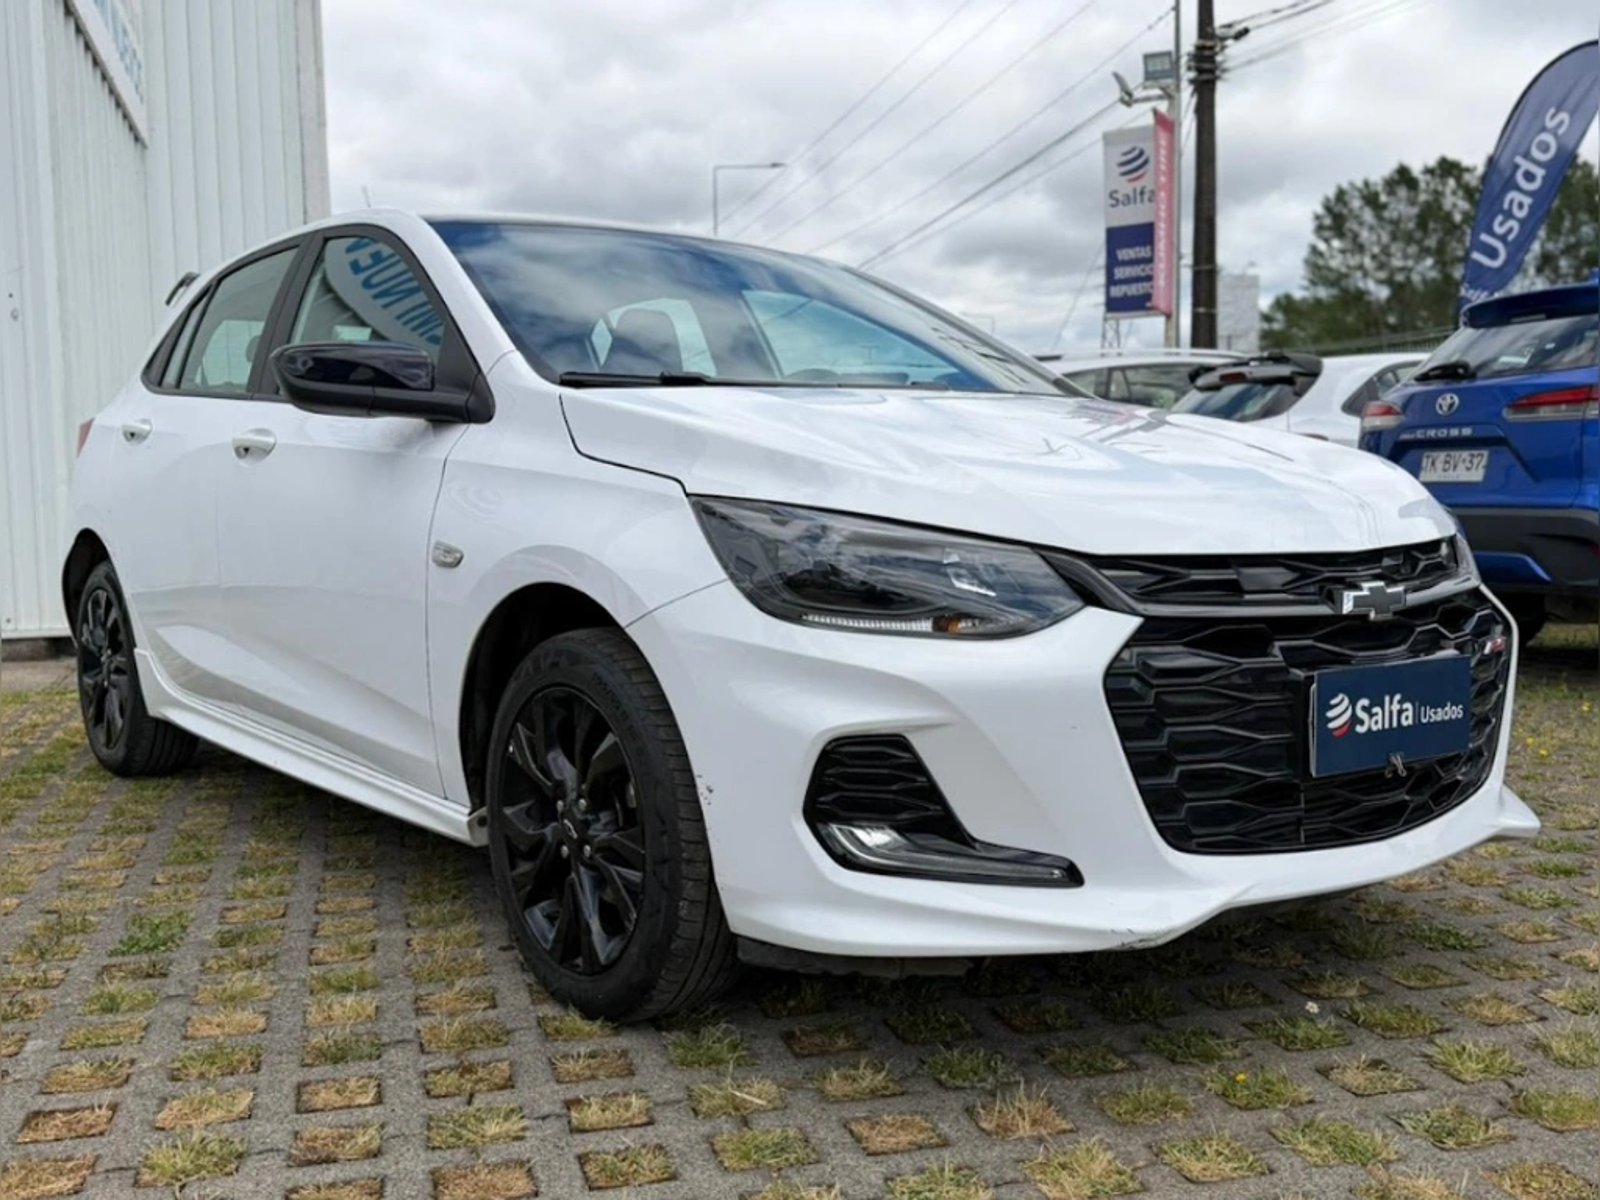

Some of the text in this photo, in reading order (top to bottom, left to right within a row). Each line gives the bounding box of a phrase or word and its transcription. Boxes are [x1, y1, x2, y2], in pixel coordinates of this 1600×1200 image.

[1109, 185, 1156, 208] Salfa
[1471, 106, 1570, 269] Usados
[1116, 245, 1152, 261] VENTAS
[1355, 693, 1464, 734] Salfa Usados
